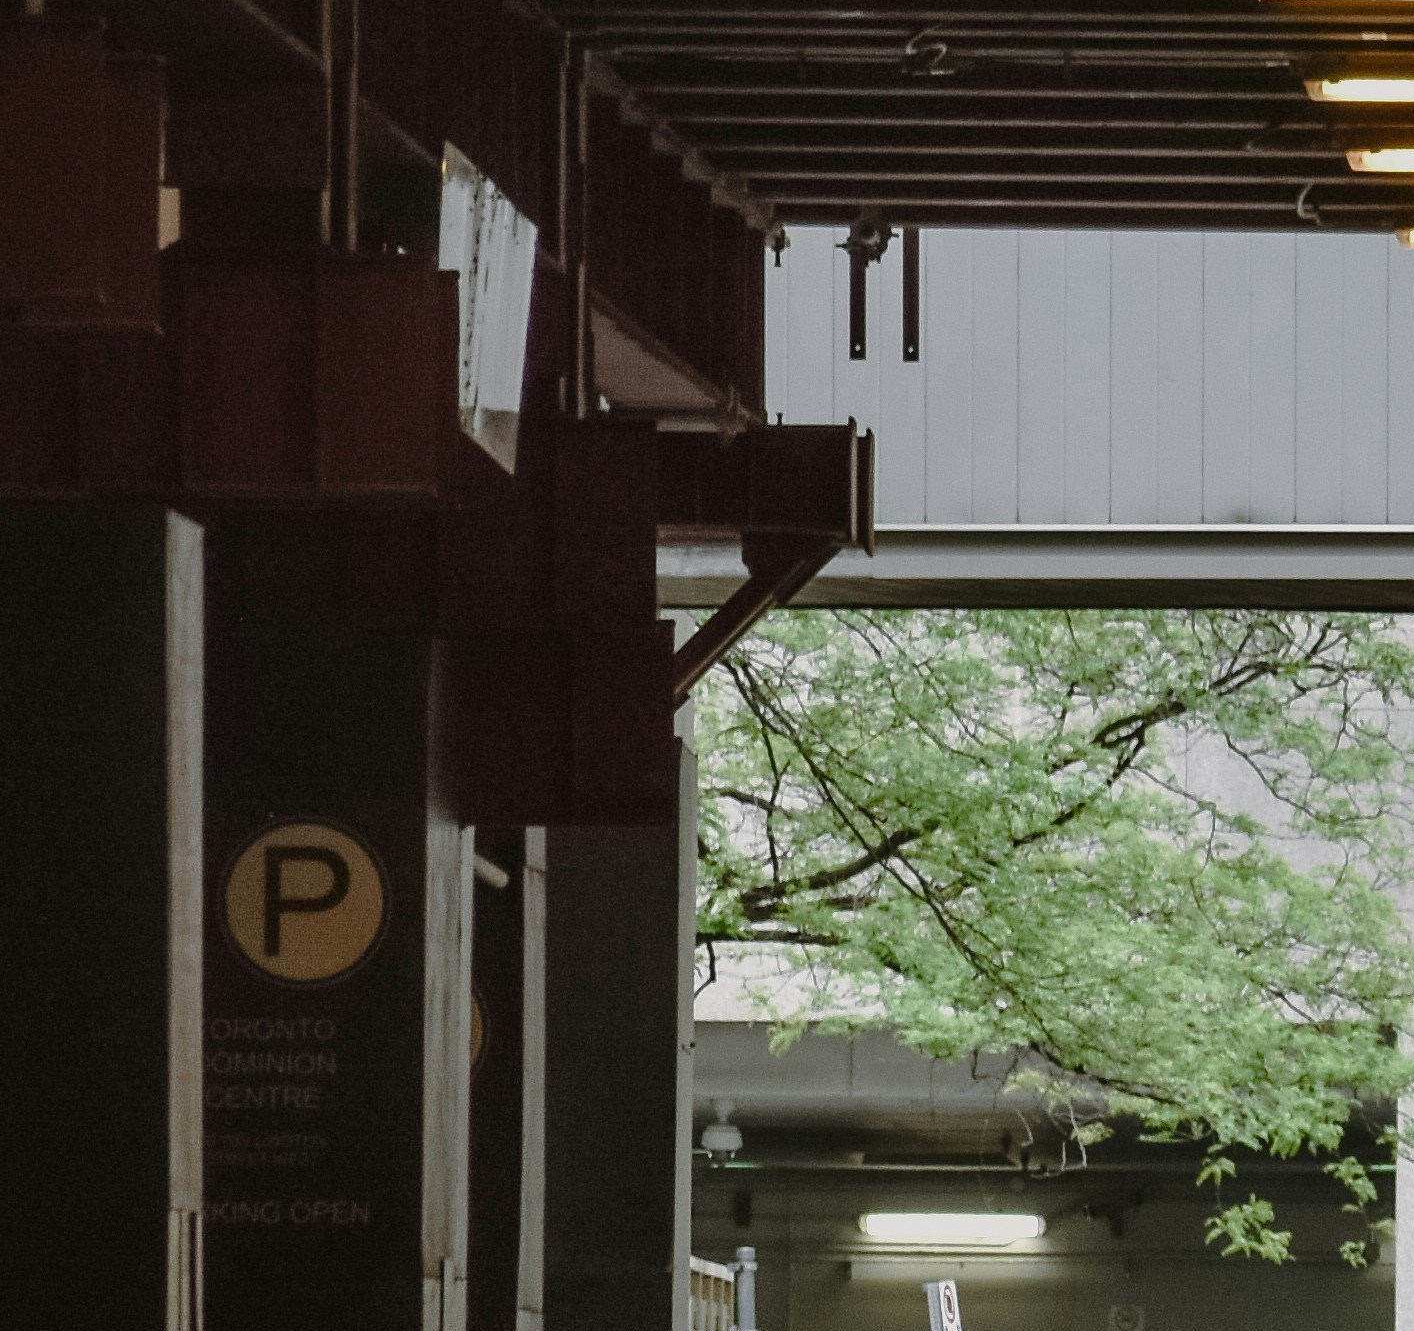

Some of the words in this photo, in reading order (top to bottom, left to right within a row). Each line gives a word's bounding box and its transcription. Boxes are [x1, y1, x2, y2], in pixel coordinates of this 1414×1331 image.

[264, 846, 350, 957] P
[203, 1017, 337, 1041] ORONTO
[203, 1085, 321, 1109] CENTRE
[289, 1200, 370, 1225] OPEN
